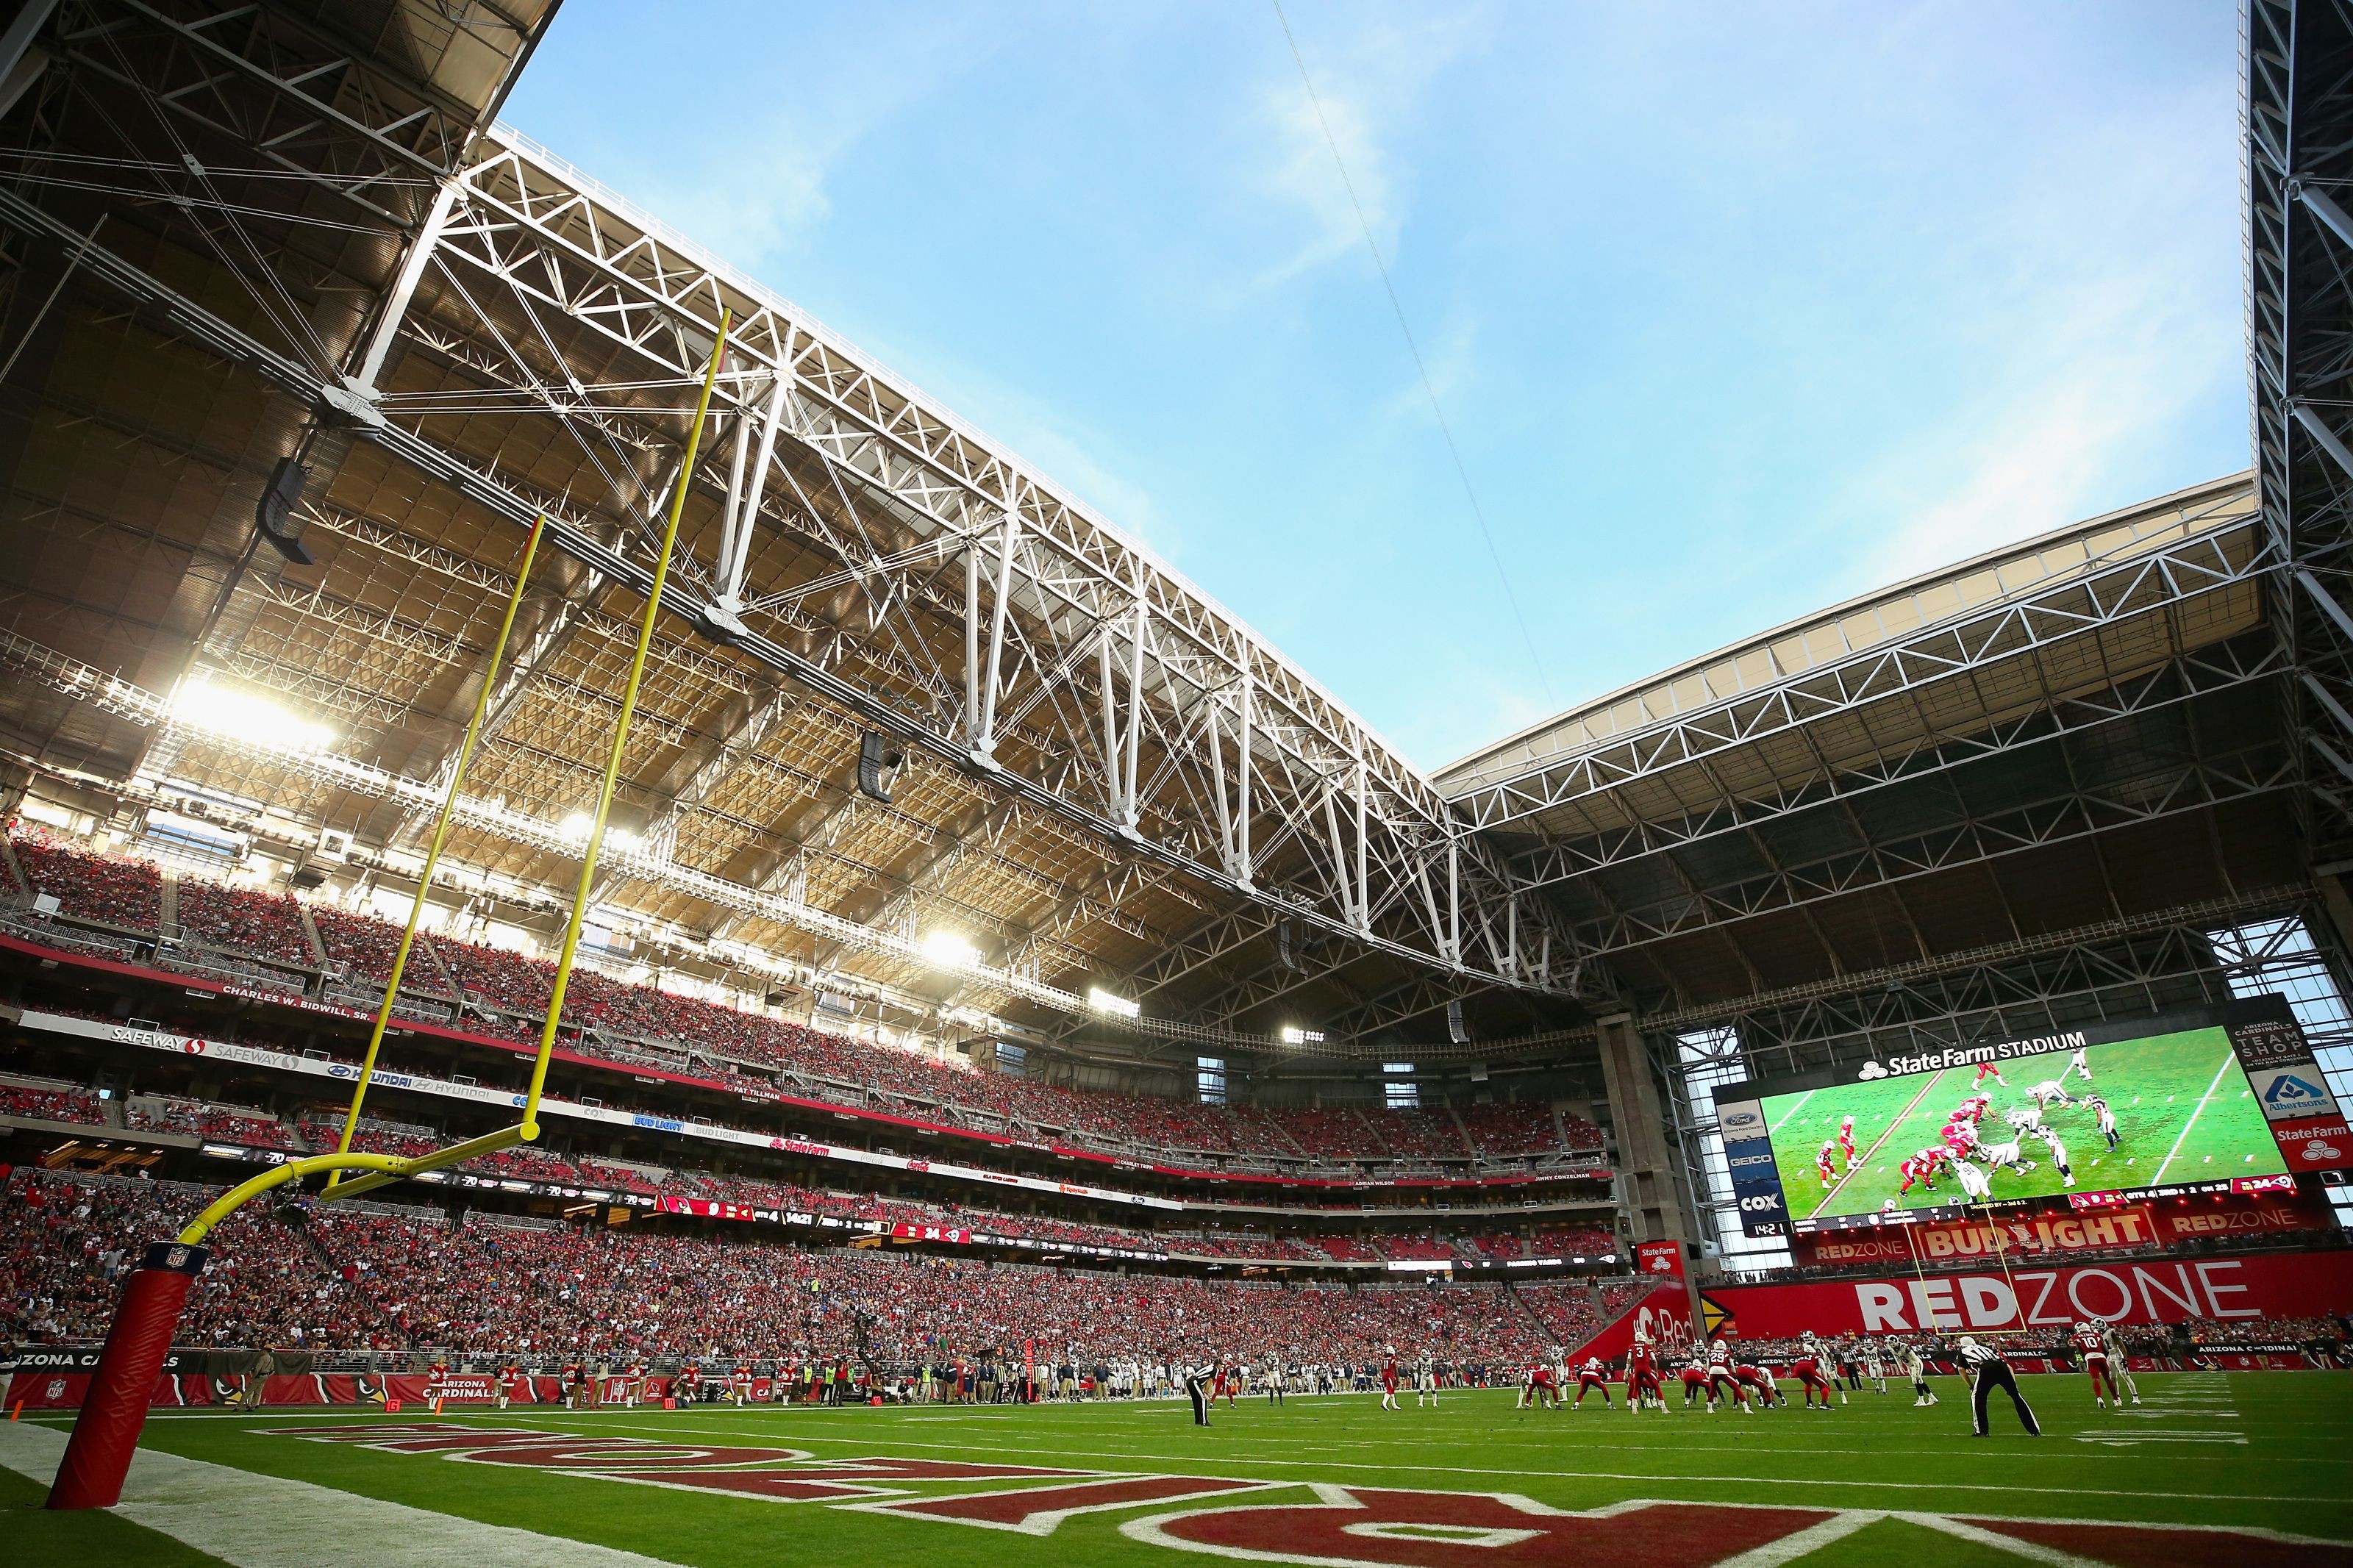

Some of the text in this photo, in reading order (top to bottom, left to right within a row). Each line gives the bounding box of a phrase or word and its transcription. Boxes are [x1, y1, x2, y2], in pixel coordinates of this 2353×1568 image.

[223, 985, 371, 1022] CHARLES W. BIDWILL, SR.
[2235, 1023, 2292, 1036] CARDINALS
[2244, 1021, 2278, 1029] ARIZONA
[112, 1028, 185, 1050] SAFEWAY
[1998, 1031, 2086, 1059] STADIUM
[2237, 1031, 2299, 1048] TEAM
[215, 1045, 280, 1066] SAFEWAY
[2242, 1041, 2302, 1057] SHOP
[352, 1069, 413, 1088] HUNDAI
[435, 1084, 490, 1100] HYUNDAI
[724, 1084, 780, 1100] 40 PAT TILLMAN
[513, 1095, 528, 1106] CO
[2269, 1098, 2328, 1111] Albertsons
[583, 1108, 607, 1119] COX
[1731, 1114, 1751, 1125] Ford
[635, 1117, 684, 1132] BUD LIGHT
[696, 1127, 740, 1140] BUD LIGHT
[1016, 1140, 1032, 1148] ROGER
[1033, 1143, 1052, 1152] WEHRLI
[1121, 1159, 1139, 1167] CHARLEY
[1729, 1154, 1772, 1167] GEICO
[2090, 1195, 2101, 1204] 9
[708, 1202, 719, 1216] 9
[769, 1211, 778, 1222] 4
[787, 1212, 812, 1225] 14:21
[2172, 1209, 2298, 1232] REDZONE
[925, 1227, 940, 1240] 24
[1754, 1223, 1784, 1235] 14:21
[1925, 1214, 2140, 1256] BUD LIGHT
[1815, 1240, 1905, 1260] REDZONE
[168, 1254, 185, 1266] NFL
[1854, 1261, 2261, 1331] REDZONE
[2082, 1337, 2098, 1348] 10
[1636, 1347, 1643, 1357] 3
[1711, 1353, 1724, 1363] 29
[16, 1354, 74, 1366] IZONA
[1383, 1360, 1389, 1370] 11
[1421, 1364, 1431, 1373] 23
[48, 1387, 63, 1398] NFL
[387, 1400, 399, 1411] G
[667, 1399, 674, 1408] 10
